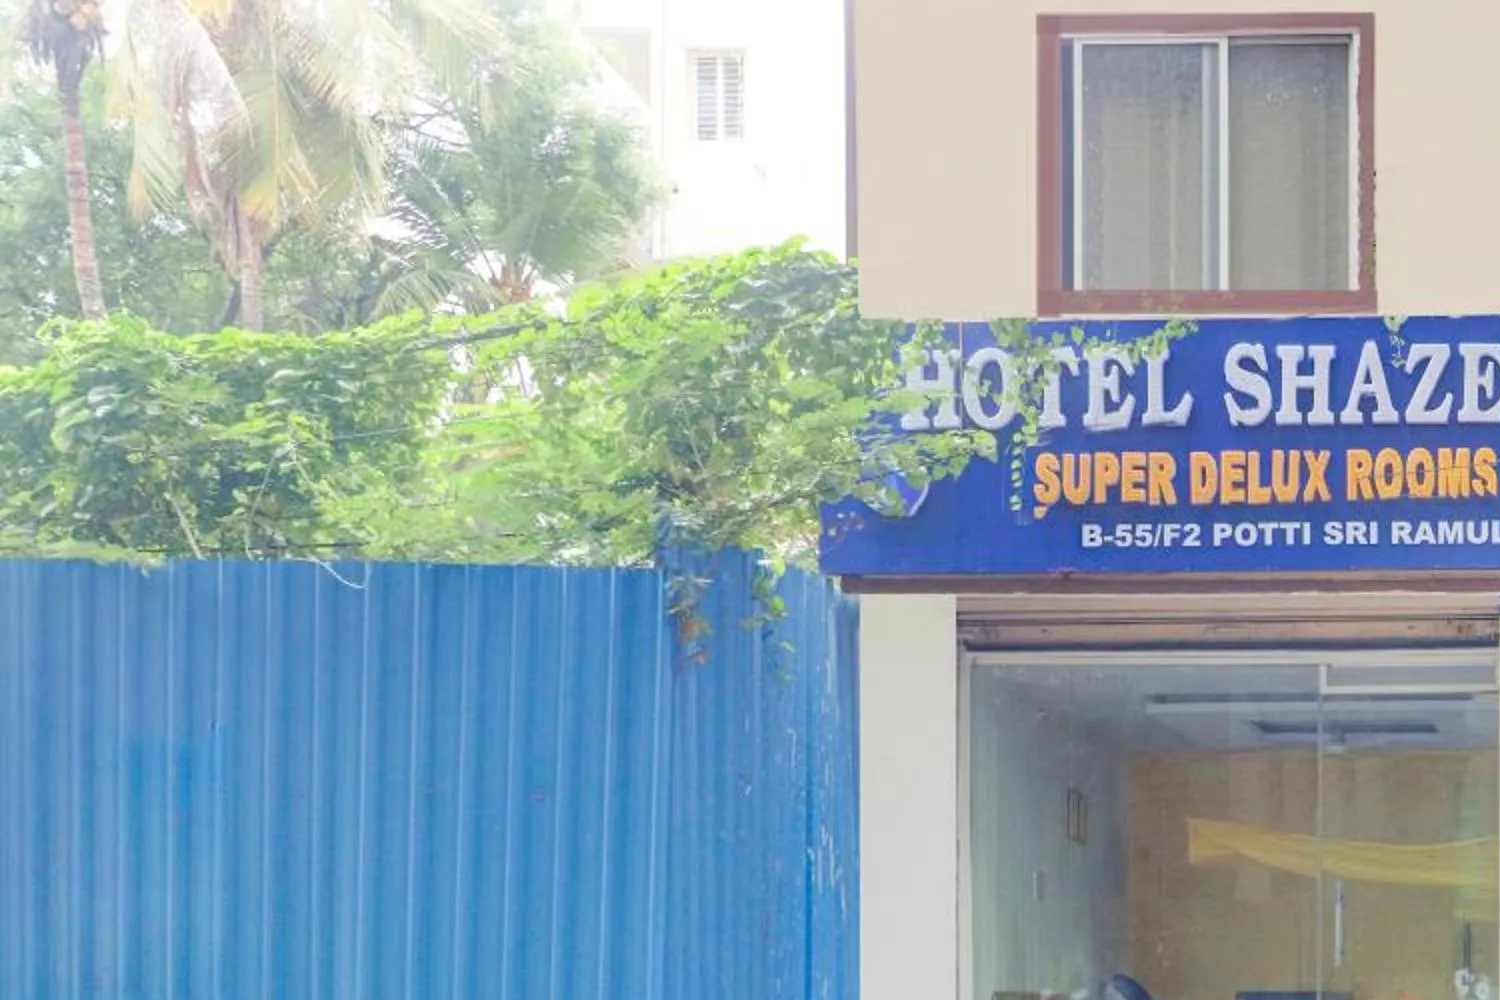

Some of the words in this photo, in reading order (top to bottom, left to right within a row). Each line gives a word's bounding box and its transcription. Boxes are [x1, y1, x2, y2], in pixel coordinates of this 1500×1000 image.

[900, 345, 1194, 431] HOTEL
[1033, 451, 1177, 518] SUPER
[1190, 449, 1331, 504] DELUX
[1347, 447, 1498, 501] ROOMS
[1081, 523, 1201, 547] B-55/F2
[1213, 521, 1312, 547] POTTI
[1323, 521, 1379, 545] SRI
